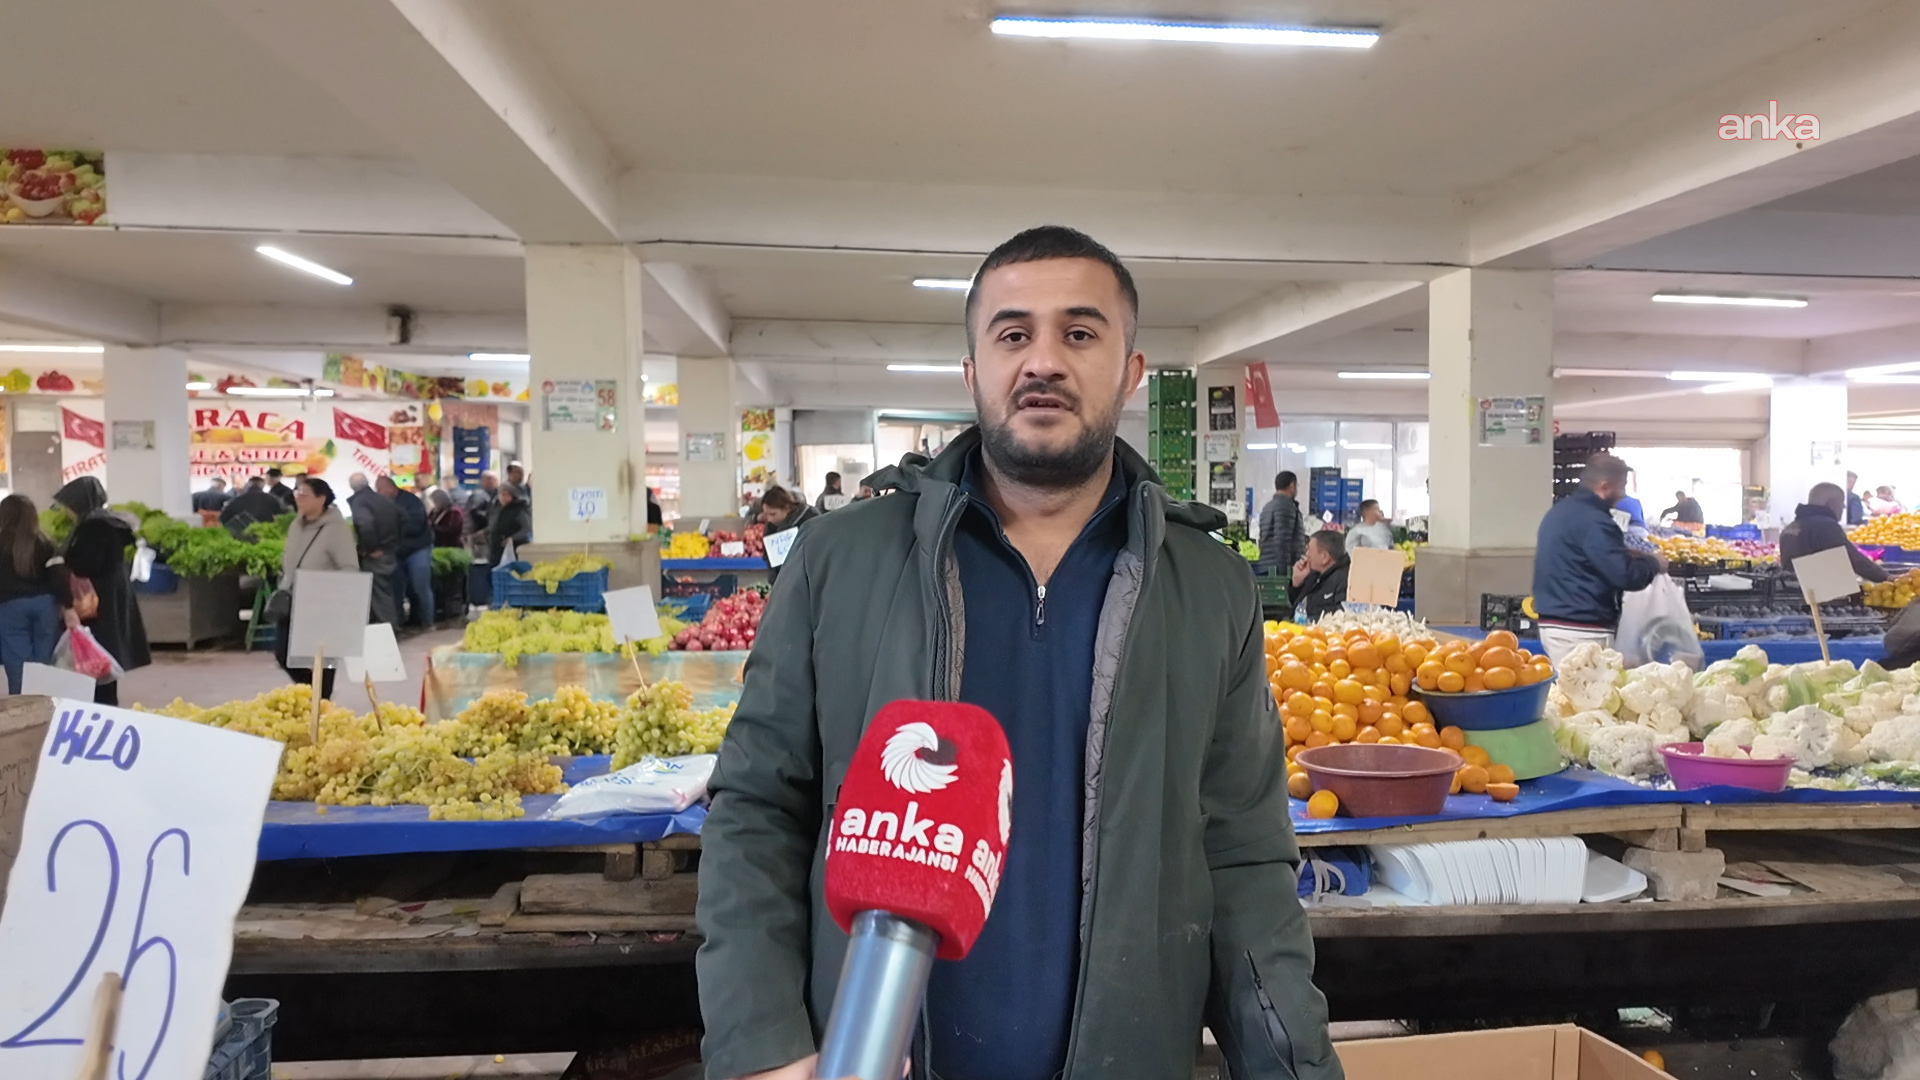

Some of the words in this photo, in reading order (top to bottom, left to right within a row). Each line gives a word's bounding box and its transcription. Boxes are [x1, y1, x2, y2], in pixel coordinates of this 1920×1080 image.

[597, 388, 616, 408] 58
[190, 408, 305, 441] RACA
[839, 800, 965, 856] anka
[835, 836, 892, 858] HABER
[891, 844, 959, 873] AJANSI
